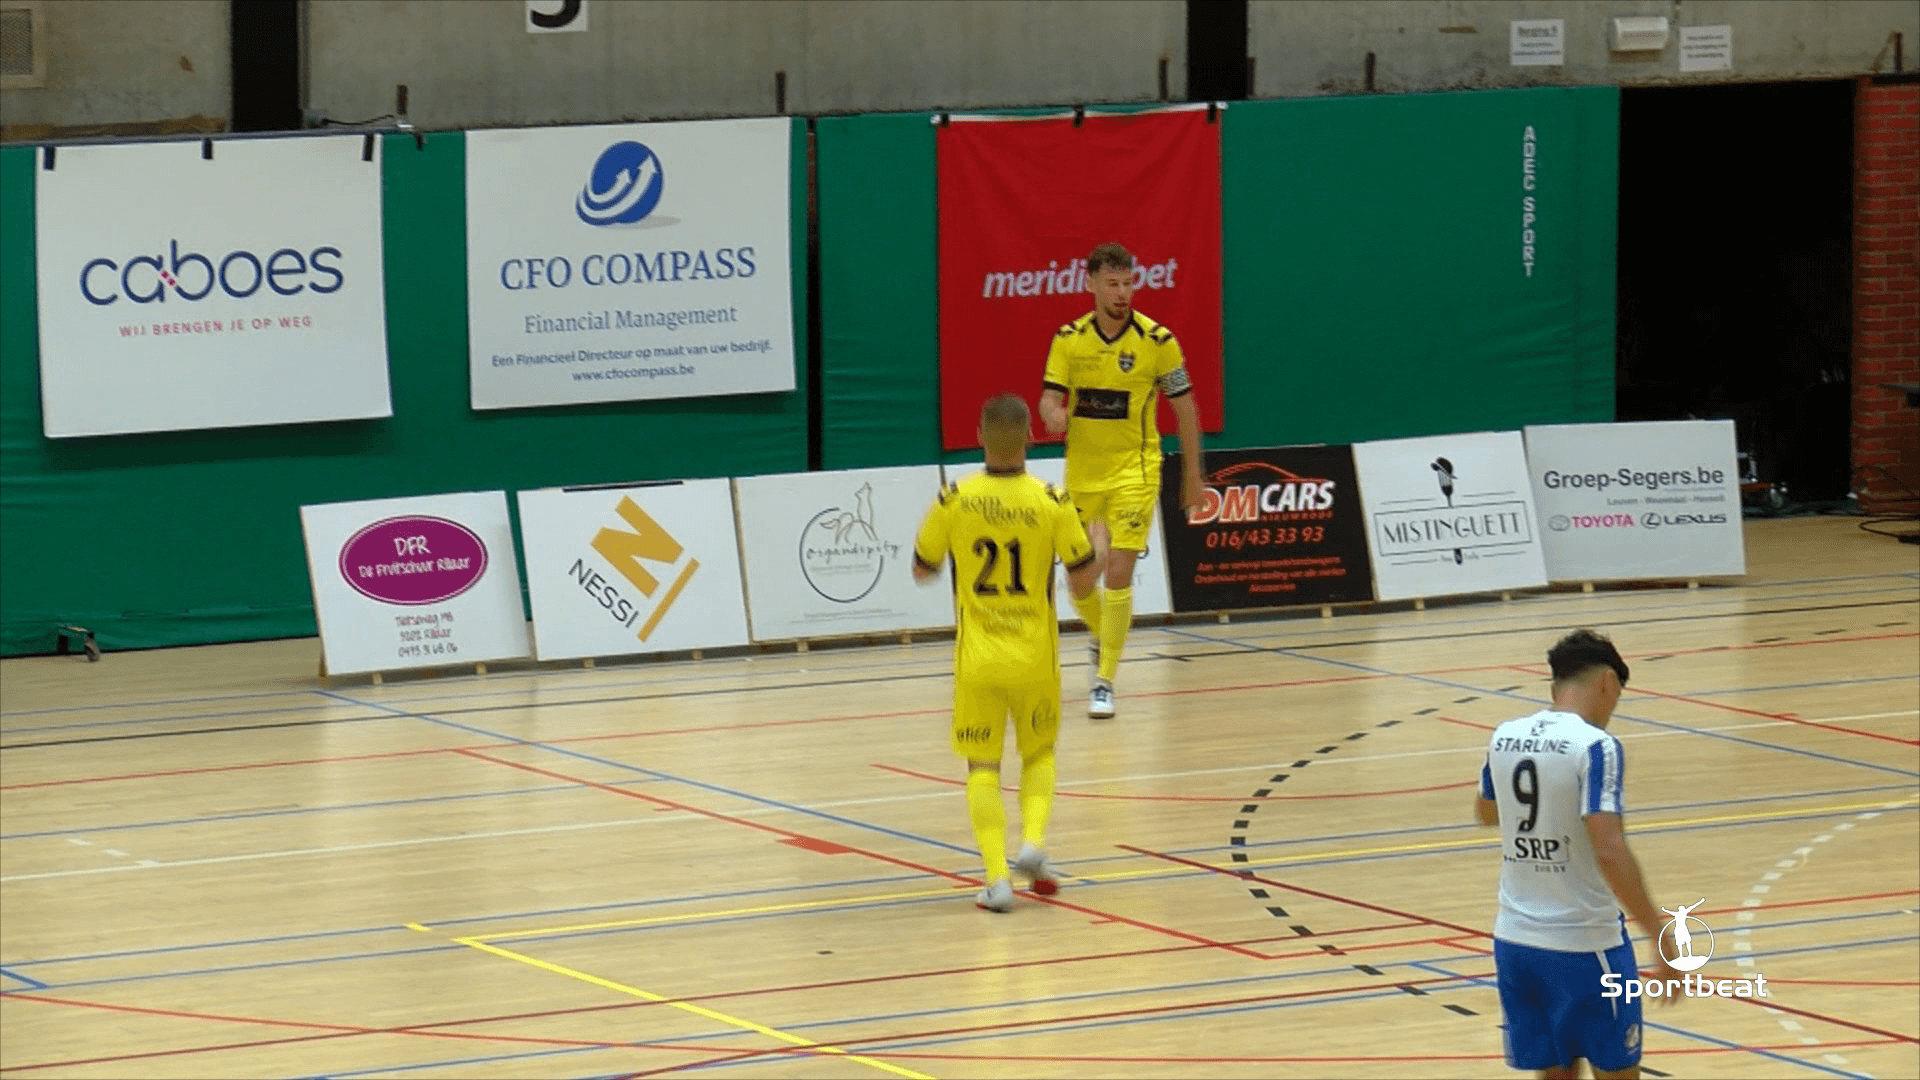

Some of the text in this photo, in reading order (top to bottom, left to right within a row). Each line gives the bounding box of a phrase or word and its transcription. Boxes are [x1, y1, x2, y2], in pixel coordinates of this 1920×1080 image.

[1522, 125, 1536, 278] ADEC SPORT
[79, 239, 344, 306] caboes
[500, 246, 757, 291] CFO COMPASS
[982, 256, 1178, 298] meridibet
[119, 315, 312, 337] WIJ BRENGEN JE OP WEG
[524, 304, 737, 334] Financial Management
[491, 354, 514, 367] Een
[516, 350, 576, 365] Financieel
[578, 348, 633, 362] Directeur
[635, 348, 652, 360] op
[654, 345, 685, 357] maat
[686, 345, 708, 355] van
[709, 345, 729, 354] uw
[572, 363, 696, 381] www.cfocompass.be
[1543, 467, 1725, 492] Groep-Segers.be
[1383, 512, 1521, 545] MISTINGUETT
[1571, 513, 1727, 529] TOYOTA LEXUS
[393, 535, 431, 557] DFR
[1205, 525, 1326, 550] 016/43 33 93
[973, 536, 1028, 597] 21
[568, 558, 640, 629] NESSI
[1494, 737, 1572, 755] STARLINE
[1512, 758, 1539, 834] 9
[1514, 836, 1560, 861] SRP
